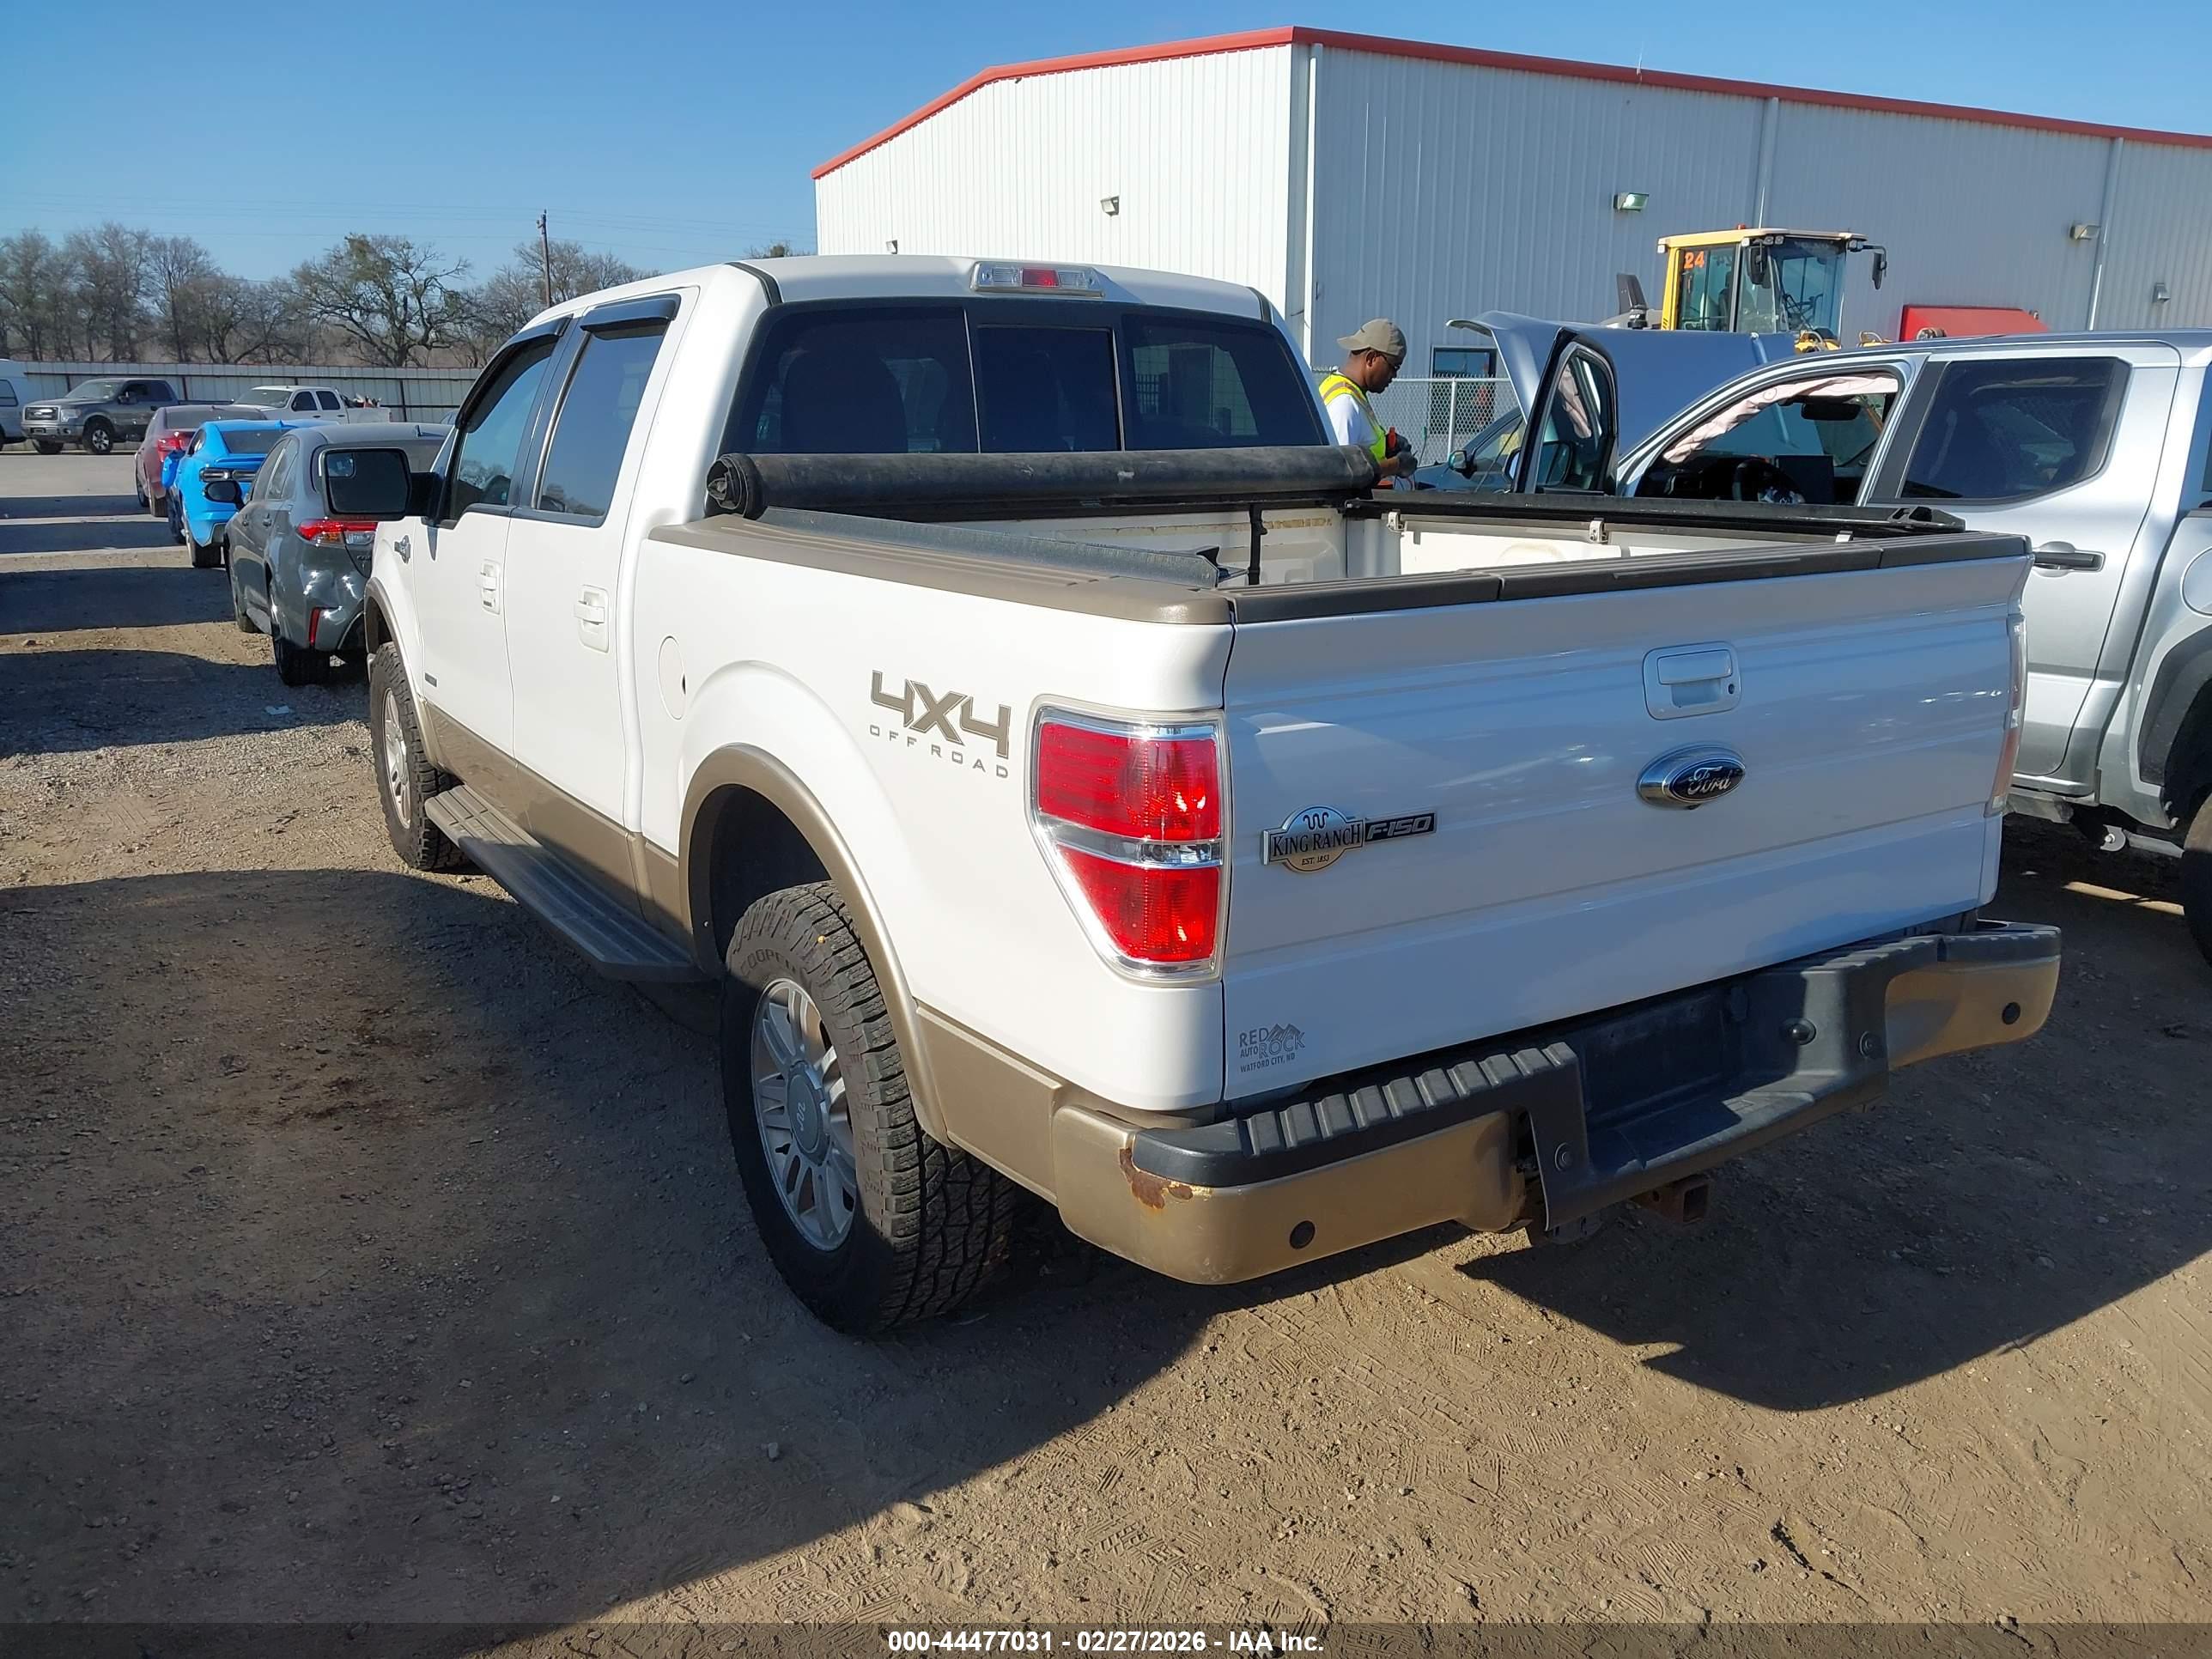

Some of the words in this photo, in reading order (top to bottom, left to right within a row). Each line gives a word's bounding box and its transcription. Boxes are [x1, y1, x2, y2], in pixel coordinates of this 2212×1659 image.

[1684, 251, 1705, 269] 24
[871, 669, 1011, 759] 4X4
[870, 725, 917, 747] OFF
[931, 744, 1008, 778] ROAD
[1687, 766, 1732, 795] Ford
[1273, 833, 1309, 856] KING
[1313, 823, 1361, 849] RANCH
[1367, 816, 1431, 840] F-150
[1302, 856, 1315, 866] EST.
[1239, 1027, 1269, 1048] RED
[1259, 1031, 1305, 1059] ROCK
[1240, 1046, 1259, 1058] AUTO
[1240, 1059, 1269, 1072] WATFORD
